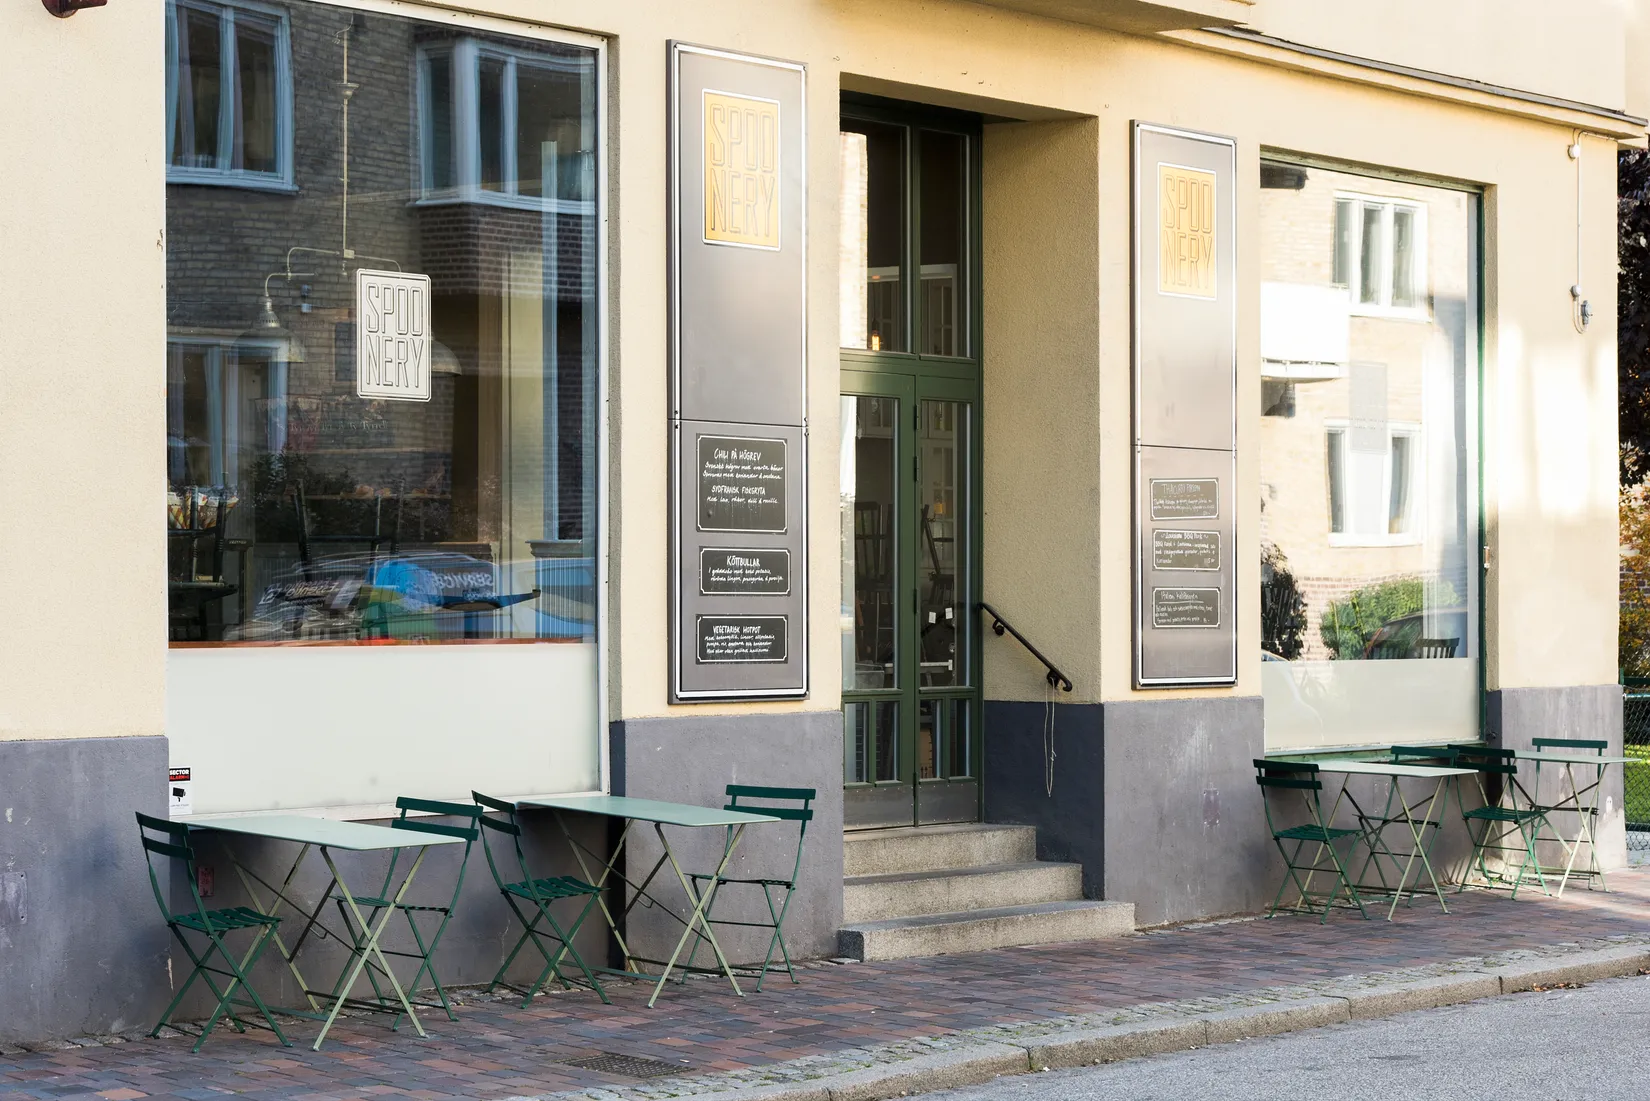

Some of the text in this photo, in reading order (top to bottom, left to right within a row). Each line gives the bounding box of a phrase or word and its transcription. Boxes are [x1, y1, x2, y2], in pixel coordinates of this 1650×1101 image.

[710, 103, 774, 173] SPOO
[710, 168, 775, 237] NERY
[1163, 174, 1212, 234] SPOO
[1163, 229, 1212, 289] NERY
[366, 283, 423, 336] SPOO
[366, 334, 423, 388] NERY
[714, 448, 761, 461] CHILI PÅ HÖGREV
[726, 555, 760, 566] KÖTTBULLAR
[713, 626, 761, 634] VEGETARISK HOTPOT
